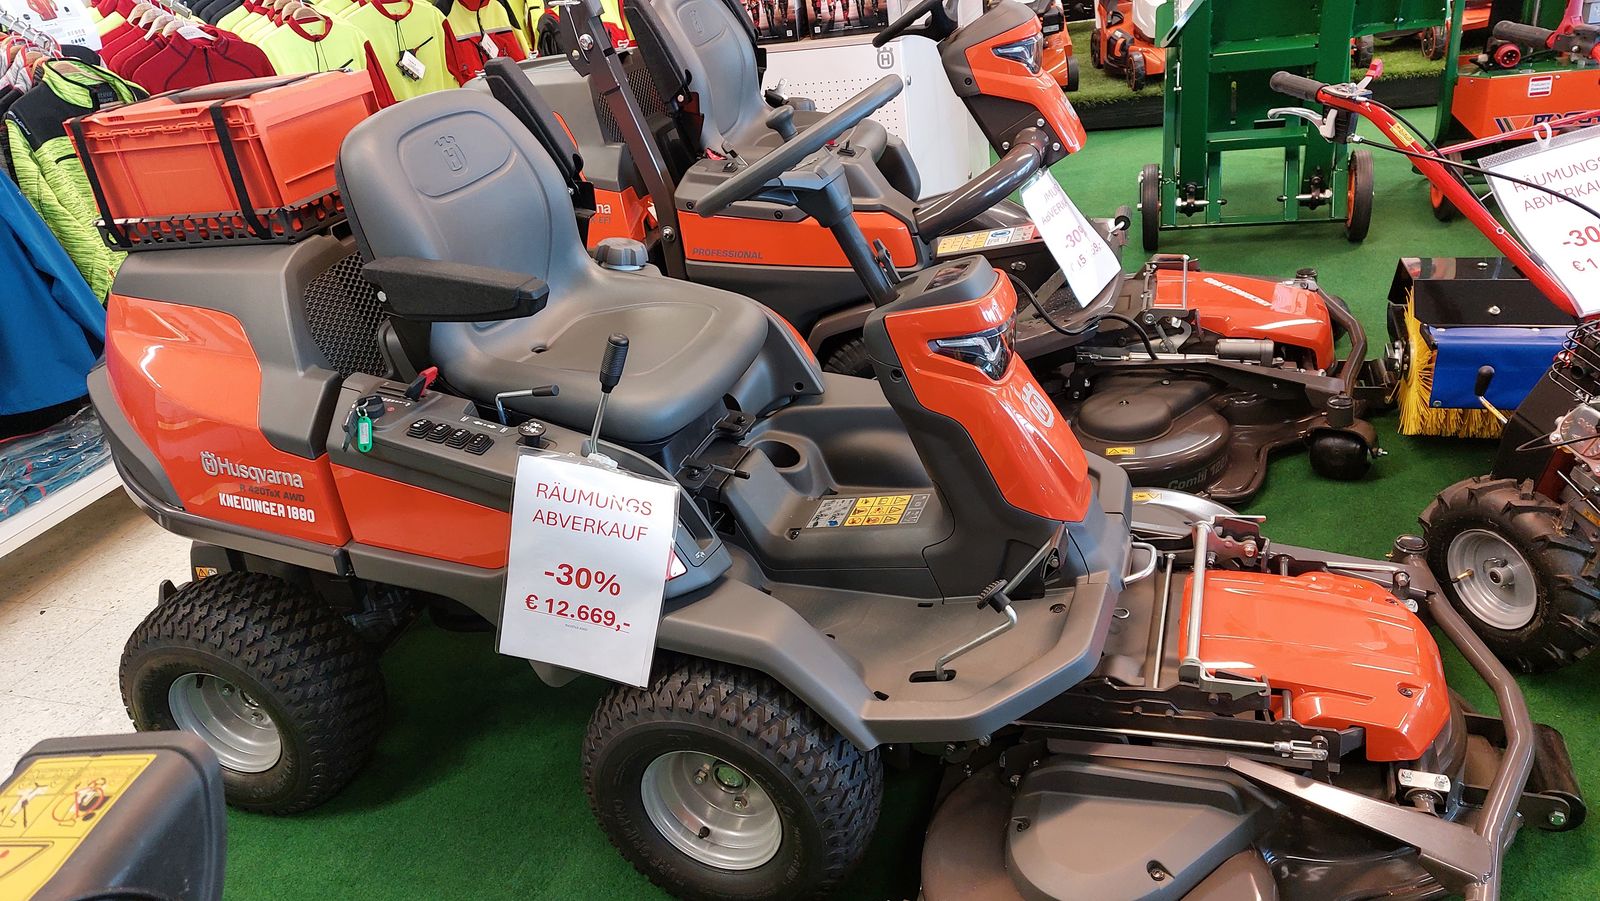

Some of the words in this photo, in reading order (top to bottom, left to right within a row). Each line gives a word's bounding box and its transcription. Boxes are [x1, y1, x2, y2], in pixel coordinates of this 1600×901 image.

[1512, 156, 1600, 193] RÄUMUNG
[1563, 225, 1600, 247] -30
[692, 247, 763, 260] PROFESSIONAL
[216, 456, 304, 489] Husqvarna
[218, 492, 286, 518] KNEIDINGER
[286, 505, 316, 523] 1880
[283, 493, 305, 503] AWD
[536, 481, 653, 516] RÄUMUNGS
[532, 508, 649, 542] ABVERKAUF
[544, 563, 621, 596] -30%
[525, 594, 539, 610] €
[545, 598, 631, 632] 12.669,-
